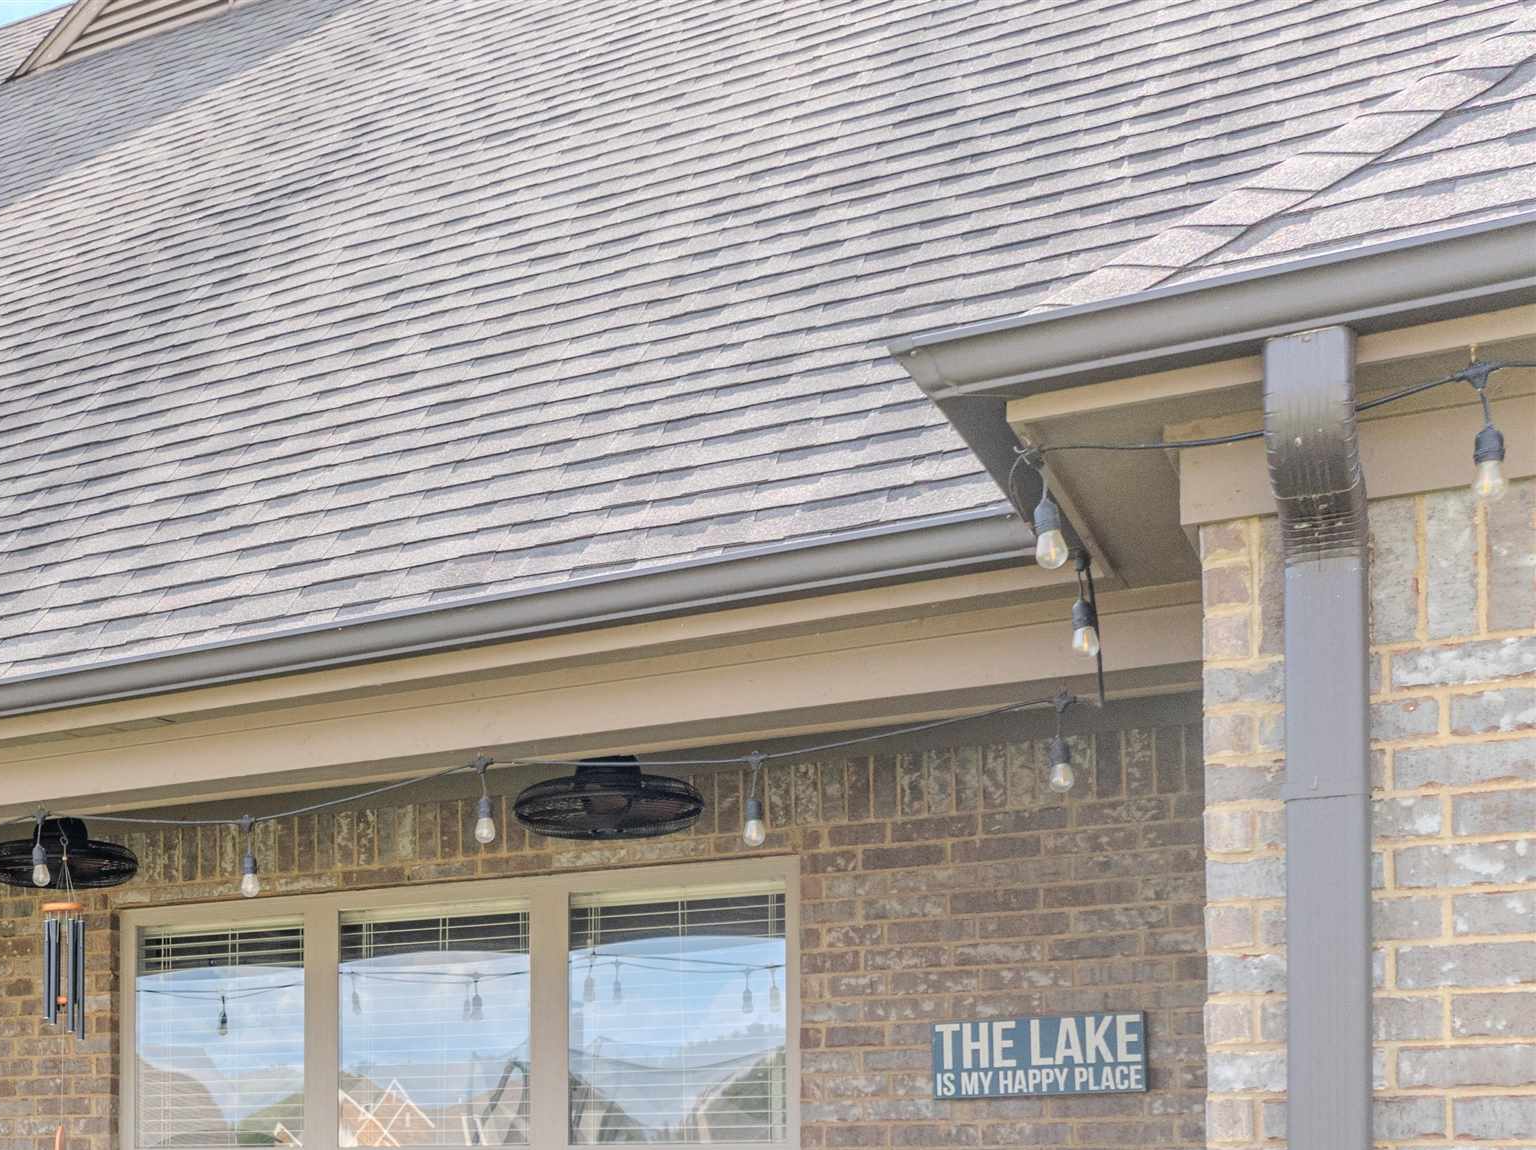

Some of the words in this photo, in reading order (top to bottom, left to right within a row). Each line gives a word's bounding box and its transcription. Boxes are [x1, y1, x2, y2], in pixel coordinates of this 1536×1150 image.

[934, 1021, 1017, 1070] THE
[1030, 1014, 1143, 1066] LAKE
[936, 1072, 956, 1097] IS
[960, 1071, 995, 1096] MY
[998, 1067, 1069, 1094] HAPPY
[1074, 1065, 1143, 1091] PLACE
